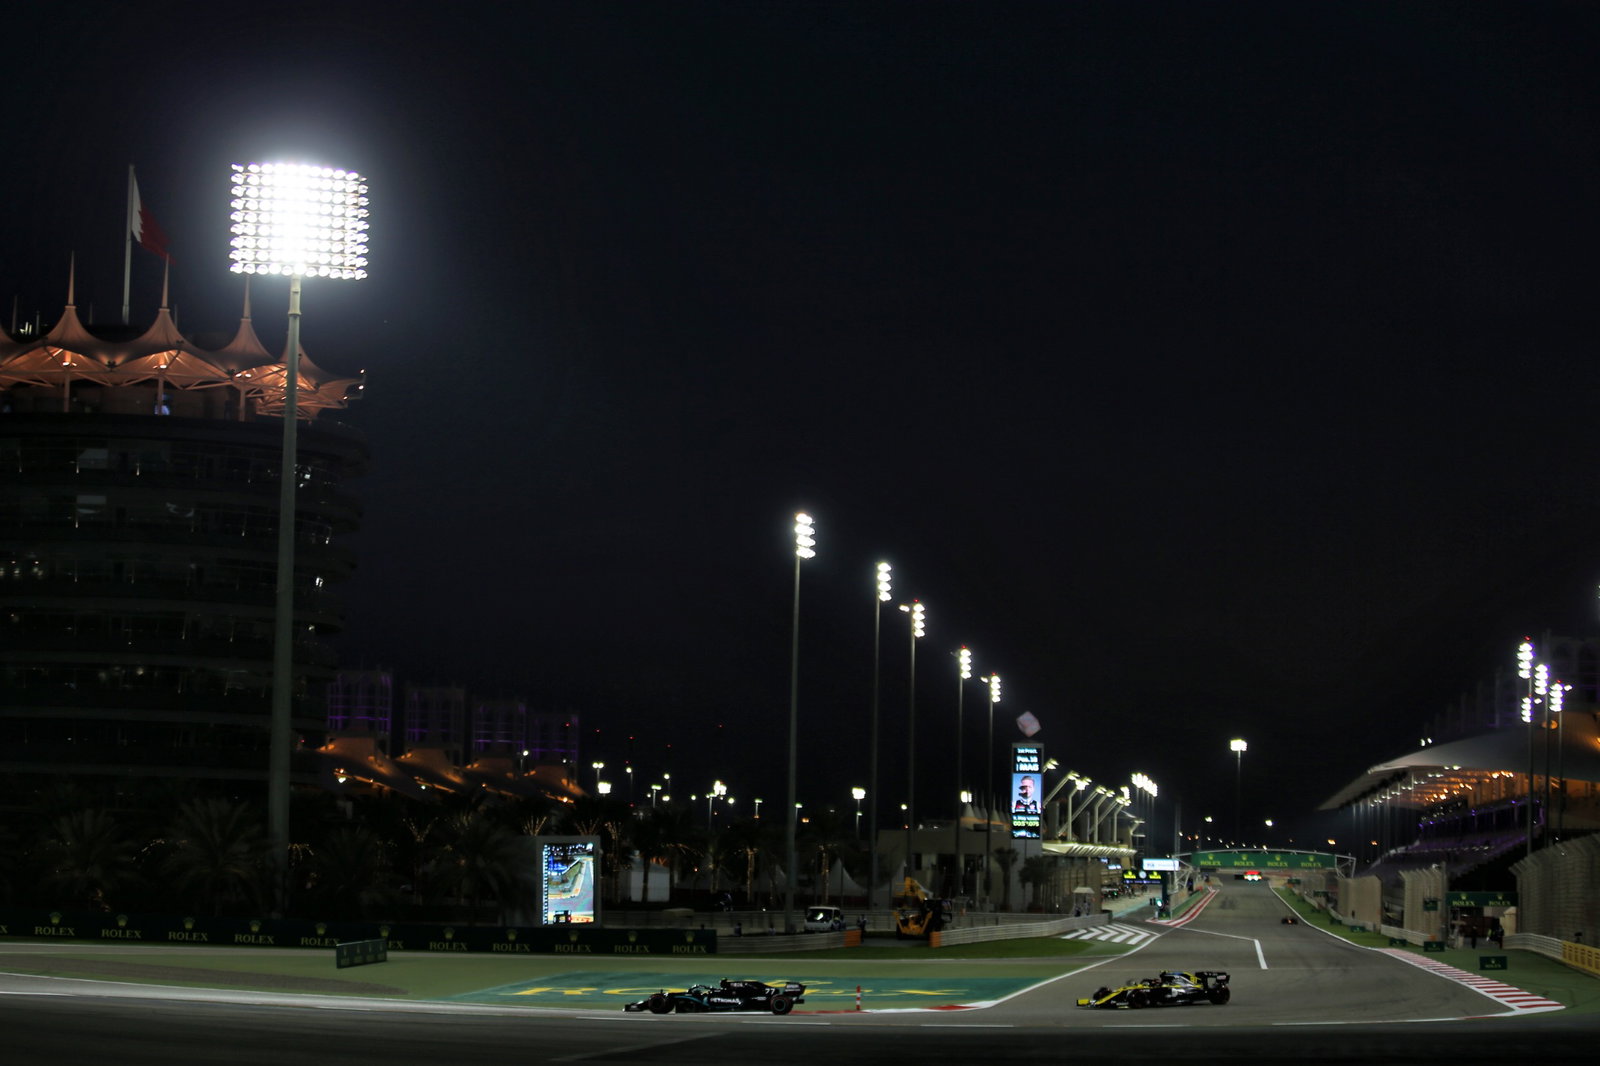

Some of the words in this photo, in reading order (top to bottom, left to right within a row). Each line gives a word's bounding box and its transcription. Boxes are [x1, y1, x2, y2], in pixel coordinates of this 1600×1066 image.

[34, 926, 75, 936] ROLEX
[101, 928, 142, 938] ROLEX
[168, 931, 208, 942] ROLEX
[234, 933, 274, 944] ROLEX
[429, 941, 468, 951] ROLEX
[493, 942, 531, 952] ROLEX
[555, 944, 592, 953] ROLEX
[614, 944, 651, 953] ROLEX
[672, 944, 707, 953] ROLEX
